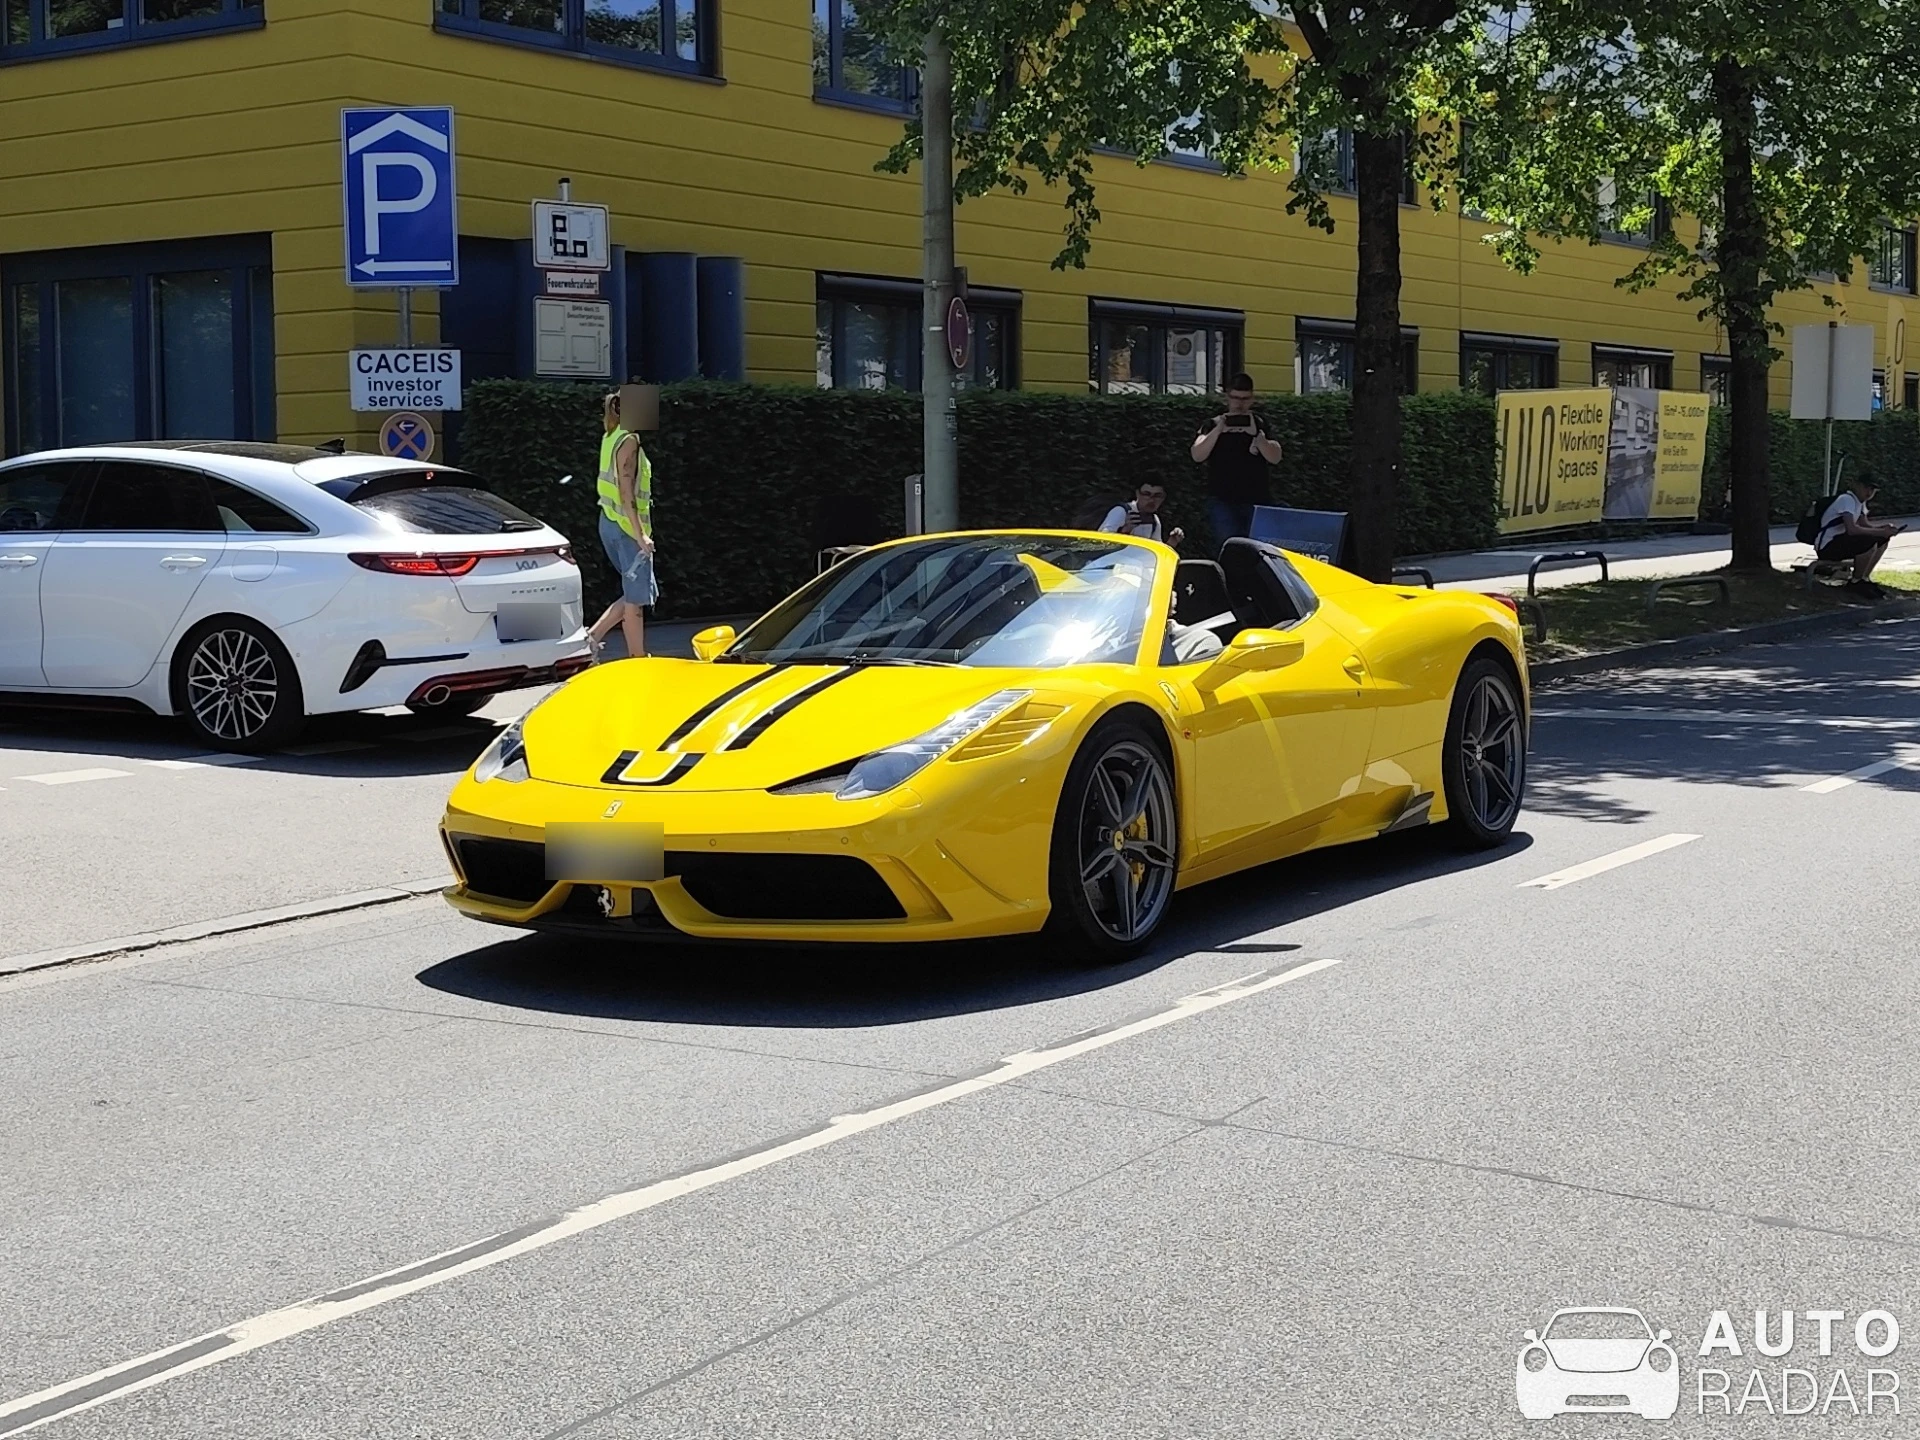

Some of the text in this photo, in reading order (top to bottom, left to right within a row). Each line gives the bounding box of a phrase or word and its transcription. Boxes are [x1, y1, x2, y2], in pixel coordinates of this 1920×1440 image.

[362, 152, 438, 255] P
[357, 352, 453, 373] CACEIS
[367, 377, 443, 391] investor
[368, 392, 444, 407] services
[1560, 404, 1603, 425] Flexible
[1559, 430, 1605, 454] Working
[1500, 405, 1555, 517] LILO
[1557, 458, 1598, 483] Spaces
